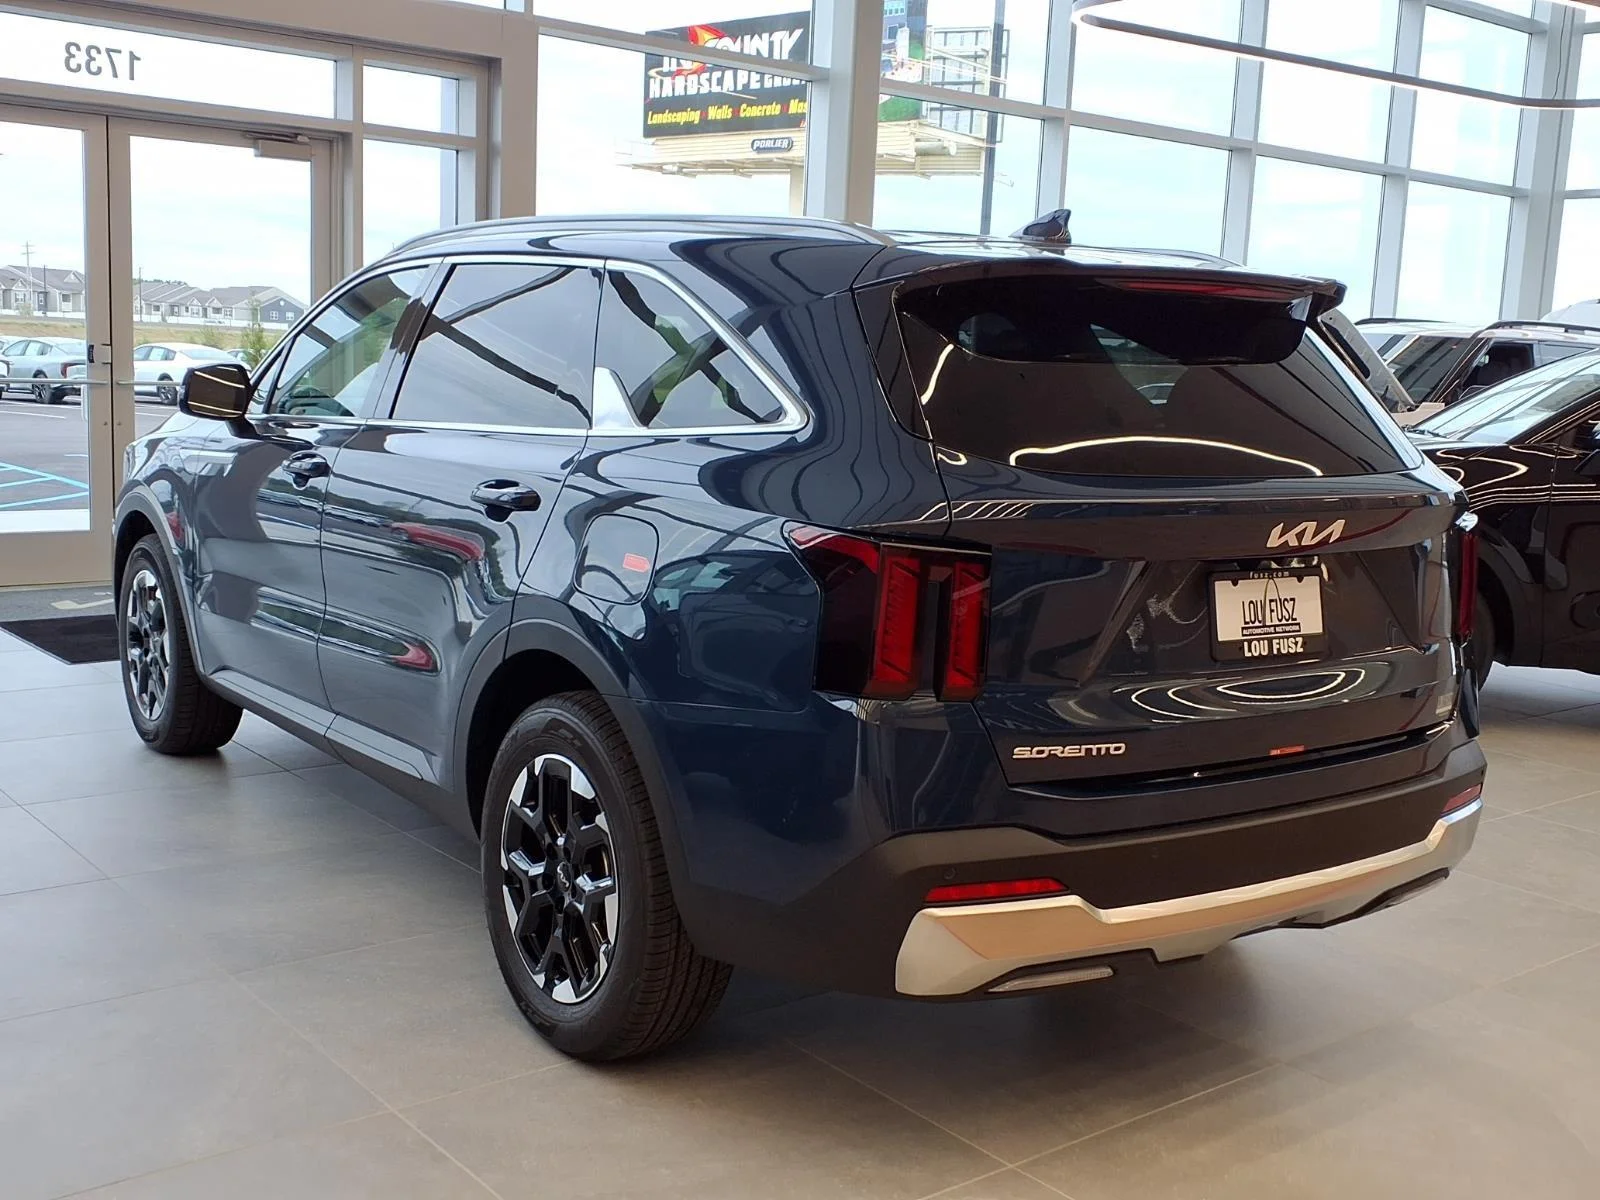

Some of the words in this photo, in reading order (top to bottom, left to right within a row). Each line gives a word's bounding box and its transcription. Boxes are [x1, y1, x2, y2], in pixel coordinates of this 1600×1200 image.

[649, 69, 761, 99] HARDSCAPE
[647, 107, 700, 125] Landscaping
[707, 104, 732, 121] Walls
[739, 101, 781, 118] Concrete
[1249, 571, 1290, 579] fusz.com
[1242, 599, 1264, 625] LOU
[1268, 597, 1298, 623] FUSZ
[1242, 627, 1275, 636] AUTOMOTIVE
[1275, 625, 1300, 633] NETWORK
[1243, 640, 1269, 657] LOU
[1272, 637, 1304, 655] FUSZ
[1012, 743, 1126, 759] SORENTO
